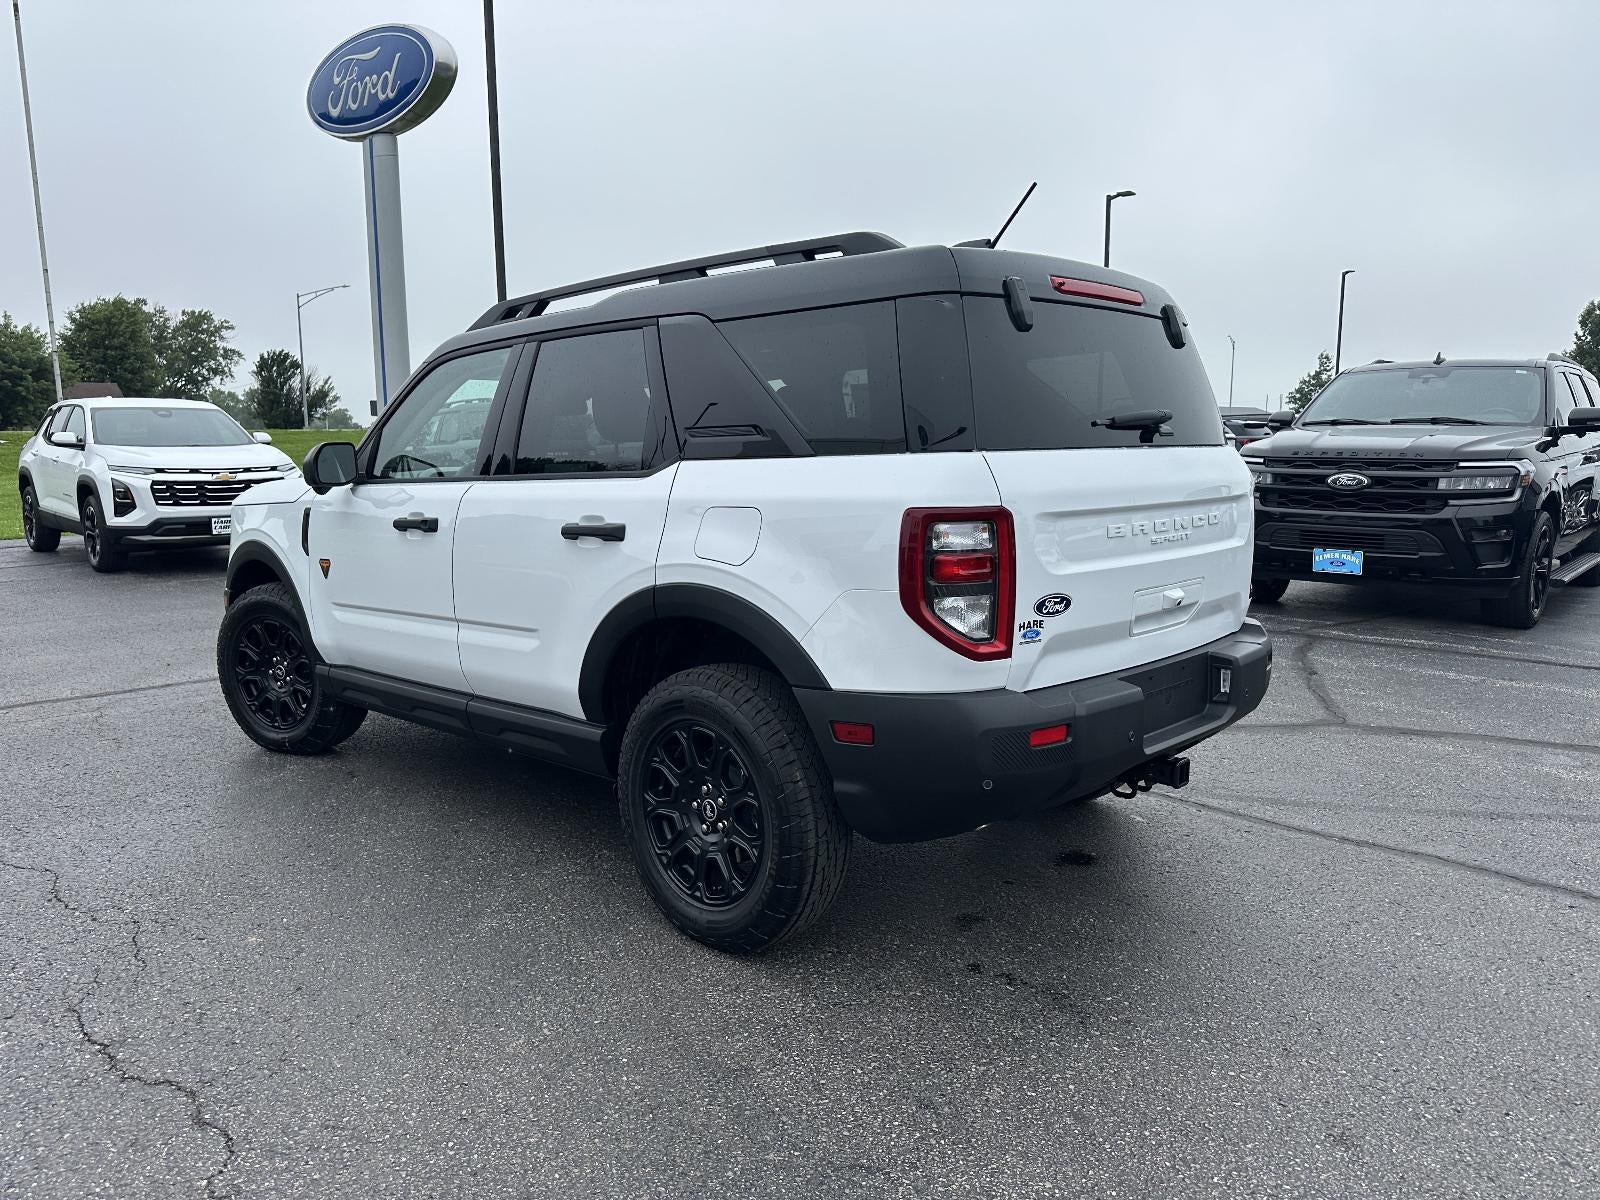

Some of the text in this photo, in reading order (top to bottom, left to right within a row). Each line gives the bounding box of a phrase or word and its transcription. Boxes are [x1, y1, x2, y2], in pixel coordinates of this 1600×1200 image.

[328, 46, 401, 118] Ford
[1290, 450, 1425, 458] EXPEDITION
[1106, 512, 1220, 538] BRONCO
[1150, 532, 1192, 545] SPORT
[1315, 552, 1340, 562] ELMER
[1042, 597, 1066, 613] Ford
[1019, 620, 1045, 632] HARE
